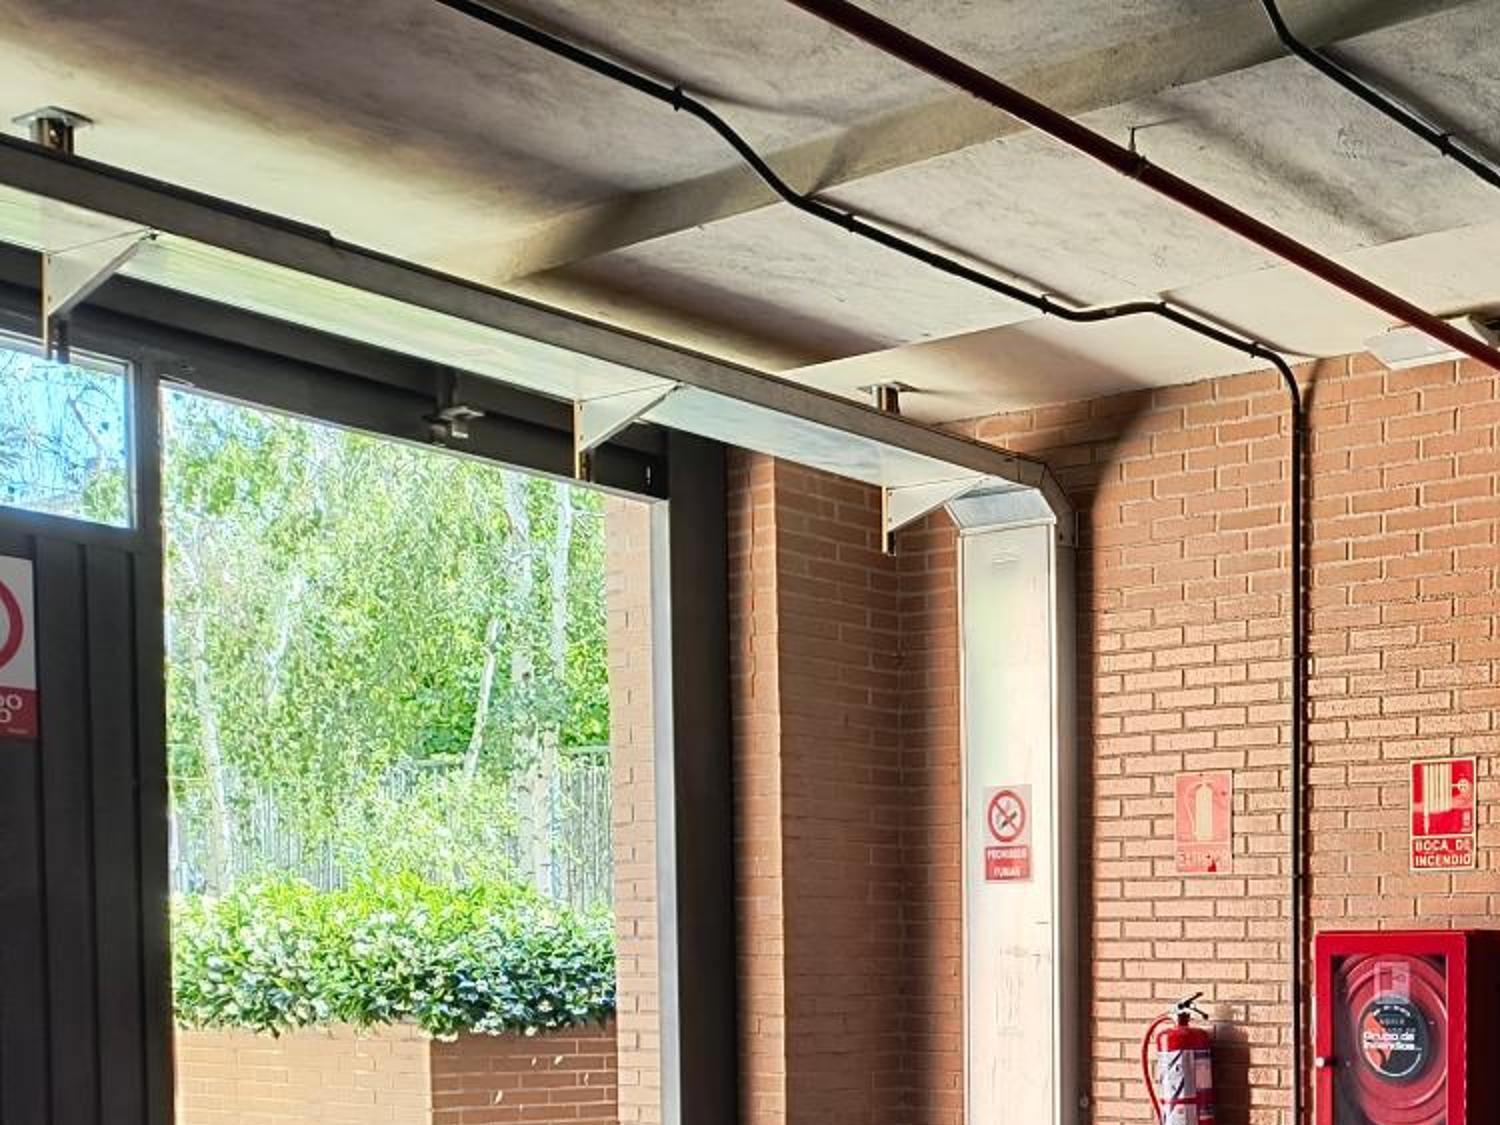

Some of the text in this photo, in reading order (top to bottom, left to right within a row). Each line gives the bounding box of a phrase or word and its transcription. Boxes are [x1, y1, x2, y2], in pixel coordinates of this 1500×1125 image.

[1415, 838, 1472, 852] BOCA DE
[1415, 853, 1471, 867] INCENDIO
